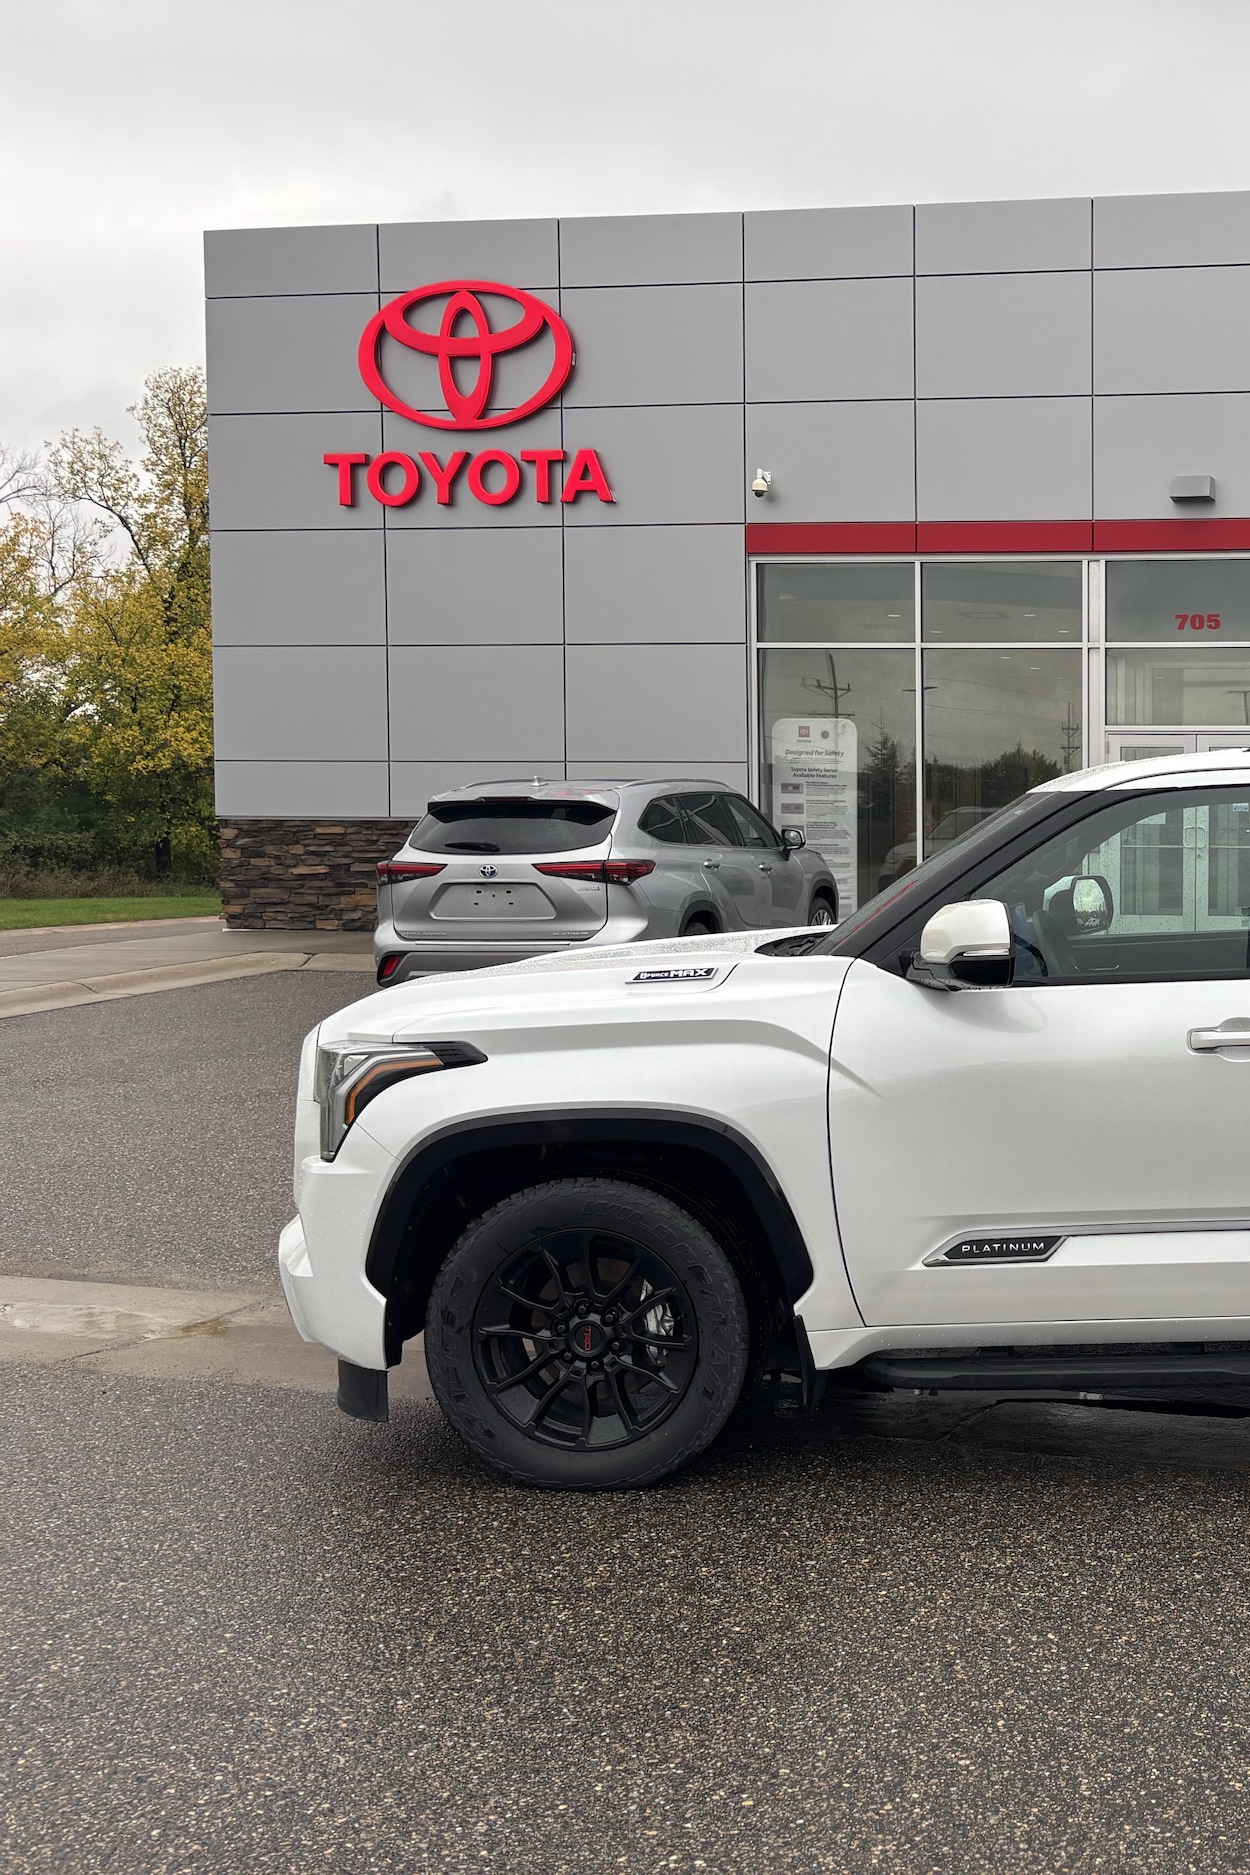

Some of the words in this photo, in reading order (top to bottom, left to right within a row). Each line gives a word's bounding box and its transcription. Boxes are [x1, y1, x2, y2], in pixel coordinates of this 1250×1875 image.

[323, 449, 616, 508] TOYOTA
[1175, 613, 1221, 631] 705
[785, 749, 814, 757] Designed
[814, 749, 824, 757] for
[824, 749, 845, 758] Safety
[669, 968, 708, 978] MAX
[961, 1242, 1045, 1253] PLATINUM
[584, 1325, 593, 1351] TRD
